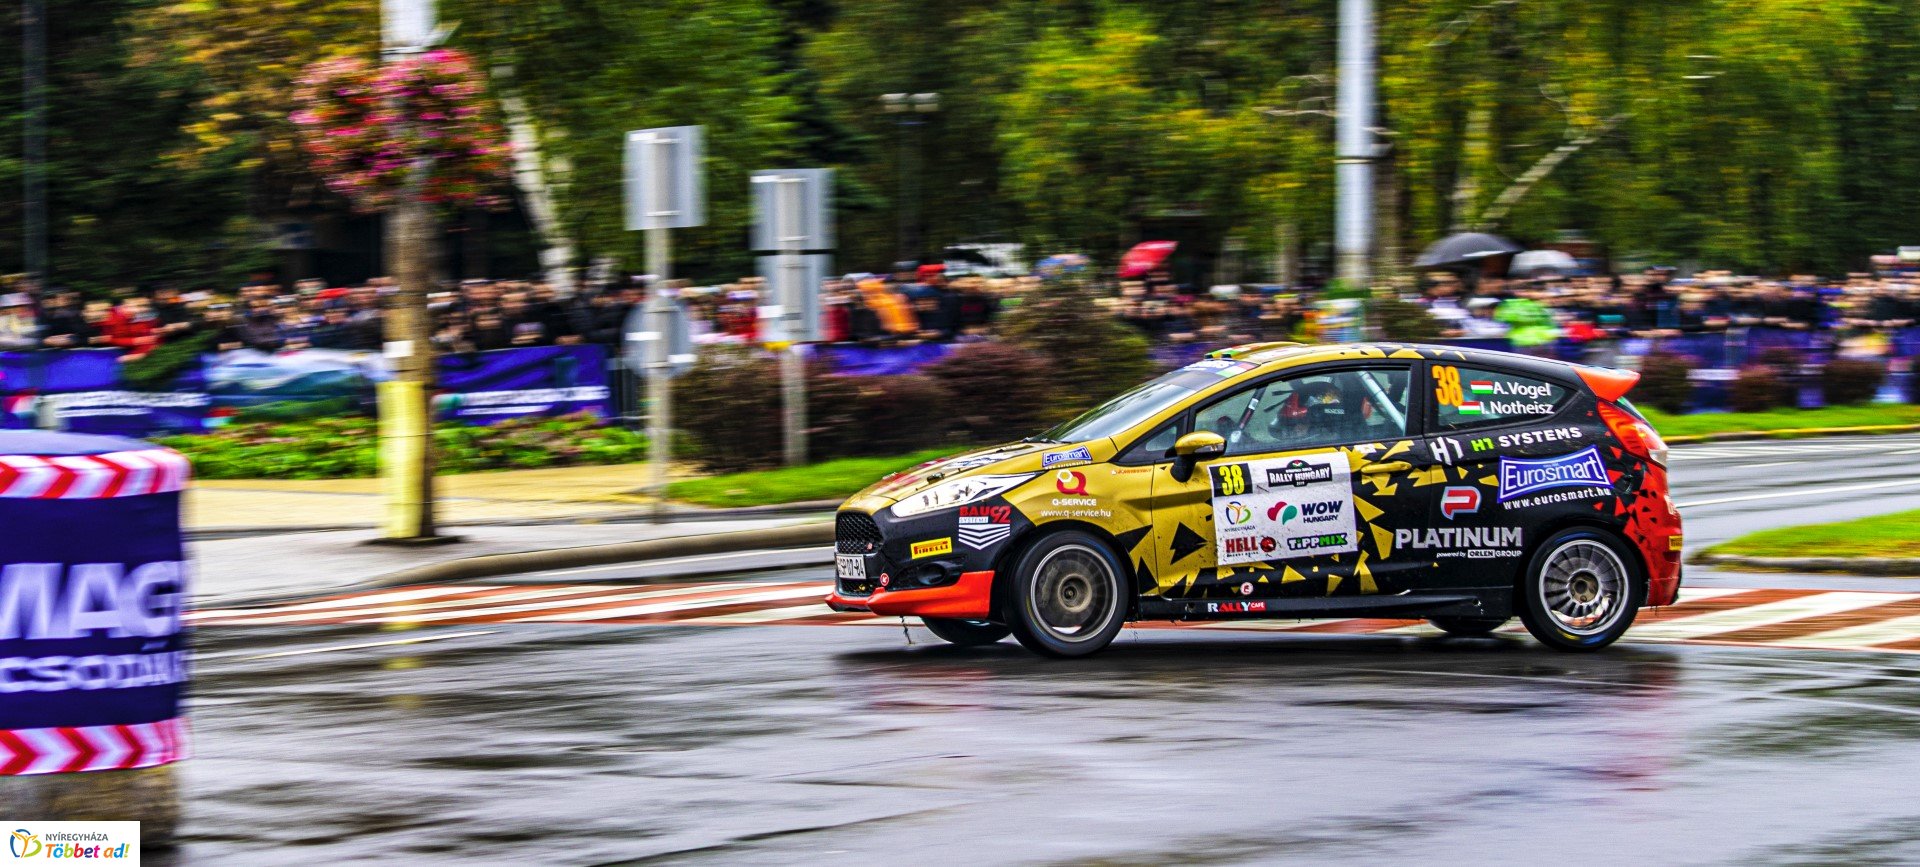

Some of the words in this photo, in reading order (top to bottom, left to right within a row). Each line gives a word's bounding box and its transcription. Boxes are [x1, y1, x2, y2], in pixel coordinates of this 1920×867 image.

[1432, 365, 1465, 407] 38
[1492, 381, 1552, 399] A.Vogel
[1480, 401, 1555, 414] I.Notheisz
[1498, 427, 1583, 448] SYSTEMS
[1045, 449, 1090, 464] Eurosmart
[1219, 464, 1245, 496] 38
[1269, 472, 1293, 483] RALLY
[1294, 467, 1330, 481] HUNGARY
[1505, 456, 1603, 490] Eurosmart
[1503, 487, 1612, 510] www.eurosmart.hu
[1041, 509, 1111, 518] www.q-service.hu
[1301, 500, 1343, 516] WOW
[1303, 514, 1339, 523] HUNGARY
[1225, 536, 1259, 553] HELL
[1395, 527, 1522, 549] PLATINUM
[913, 540, 950, 556] PIRELLI
[1436, 550, 1460, 558] powered
[1460, 550, 1466, 558] by
[1207, 601, 1250, 612] RALLY
